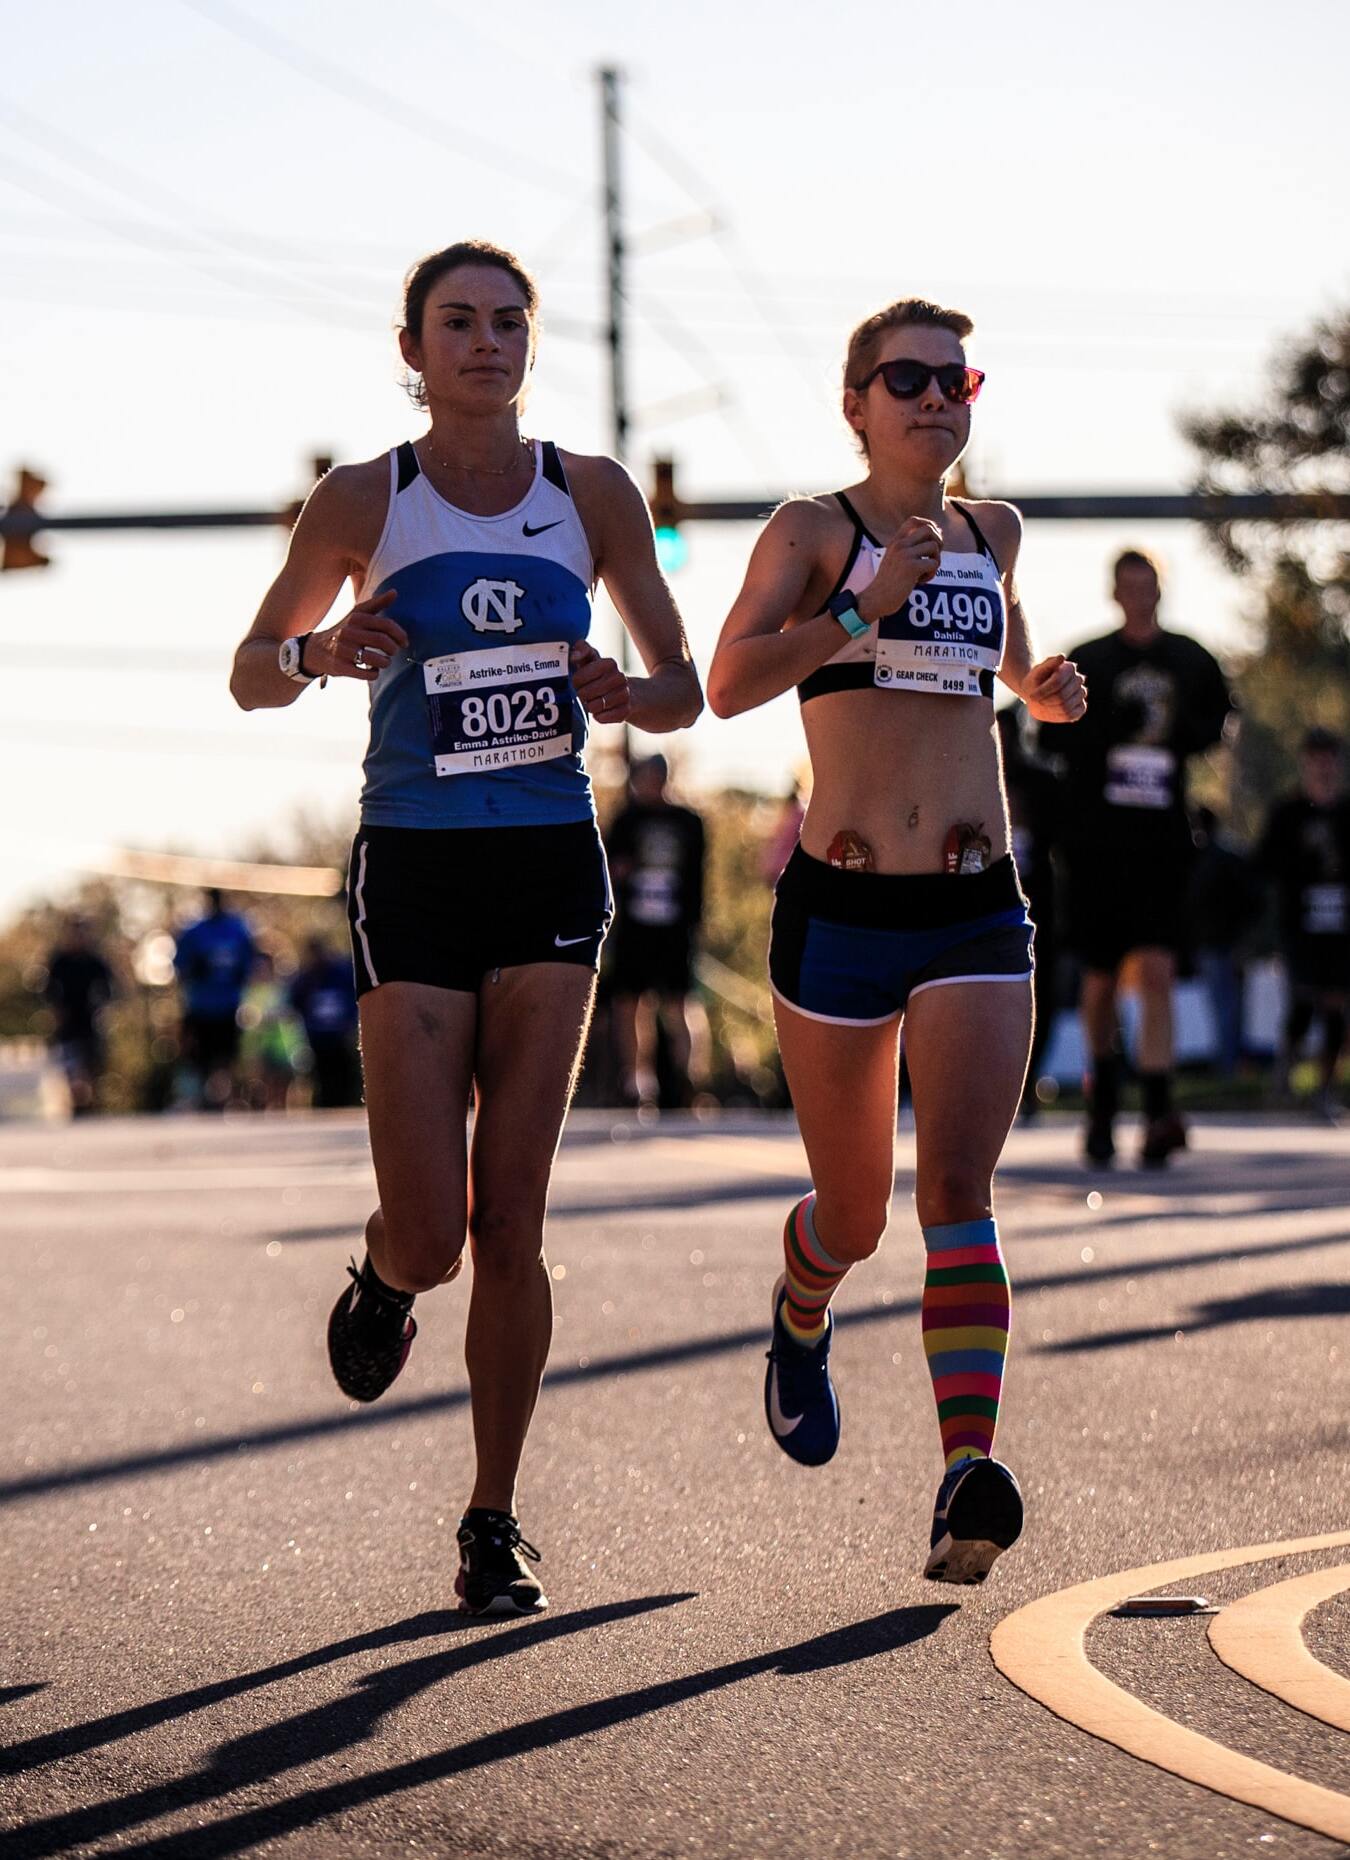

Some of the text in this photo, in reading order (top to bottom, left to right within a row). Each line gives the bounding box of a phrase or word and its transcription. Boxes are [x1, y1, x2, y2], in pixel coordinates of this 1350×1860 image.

[936, 568, 984, 580] ohm, Dahlia
[908, 589, 993, 634] 8499
[933, 630, 965, 641] Dahlia
[913, 645, 979, 661] MARATHON
[469, 662, 534, 680] Astrike-Davis,
[534, 659, 560, 671] Emma
[896, 670, 915, 680] GEAR
[916, 671, 938, 682] CHECK
[942, 679, 964, 691] 8499
[460, 686, 560, 738] 8023
[453, 728, 558, 751] Emma Astrike-Davis
[473, 744, 545, 767] MARATHON
